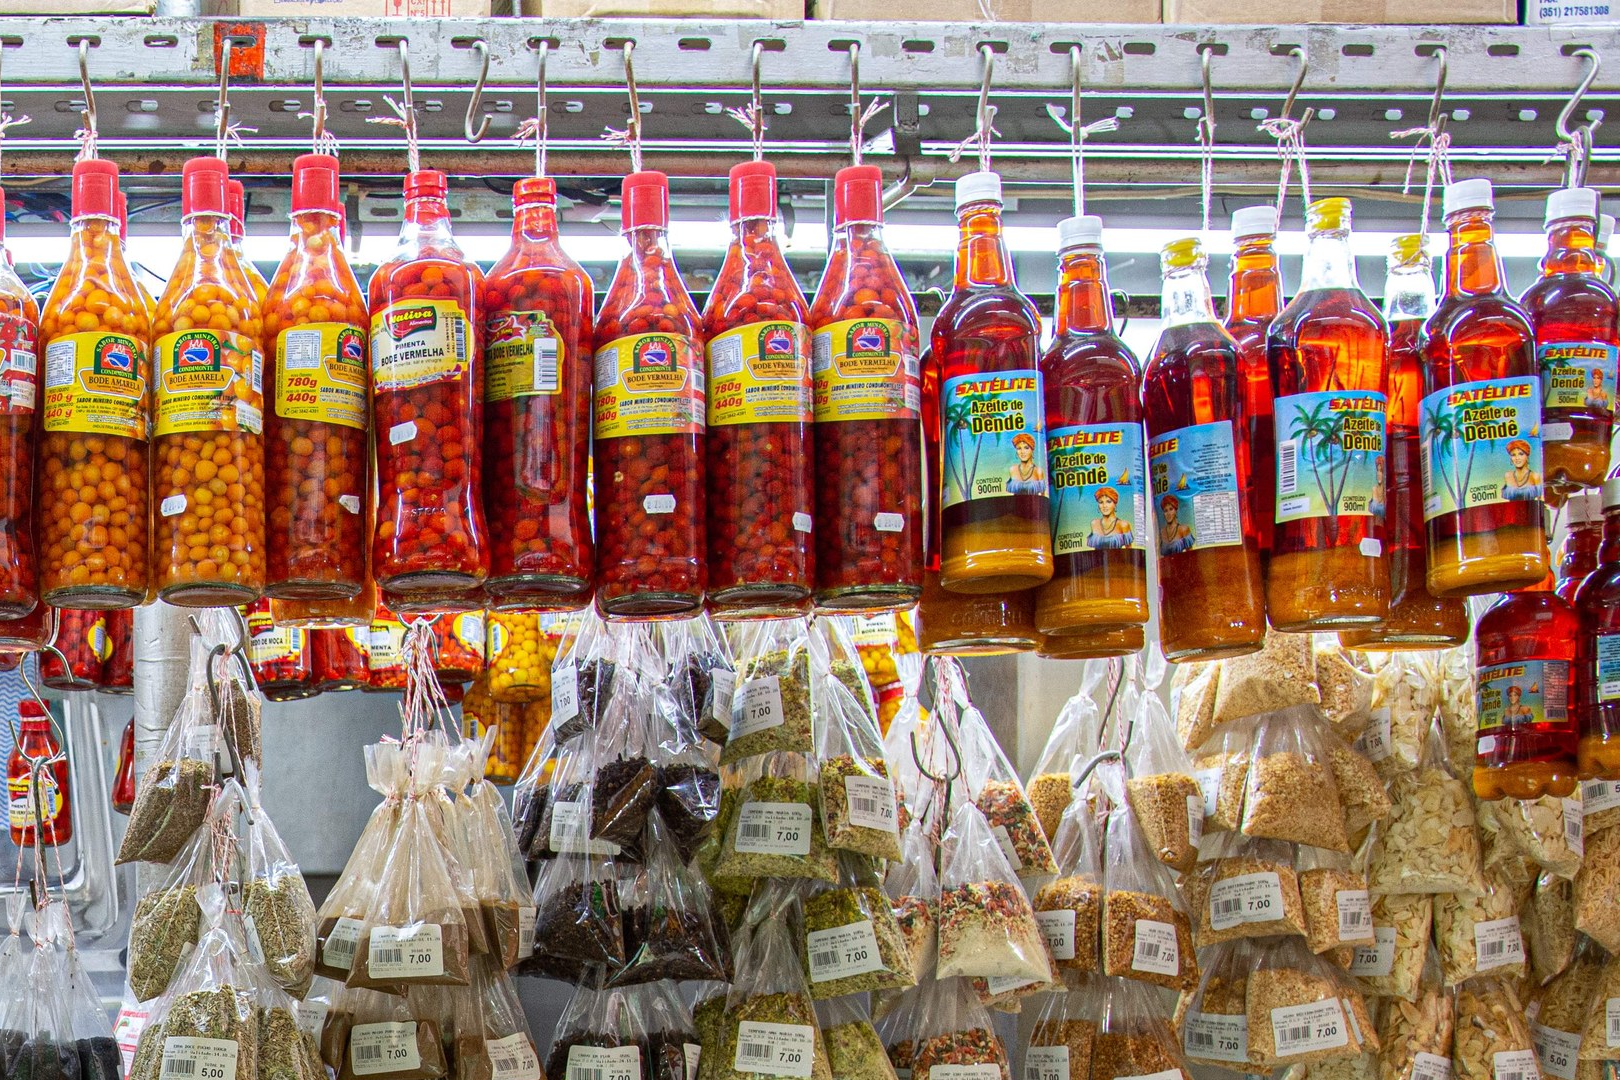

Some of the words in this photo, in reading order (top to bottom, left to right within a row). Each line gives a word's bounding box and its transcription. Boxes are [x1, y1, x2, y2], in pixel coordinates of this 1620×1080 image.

[1539, 7, 1561, 18] (351)
[1564, 6, 1609, 16] 217581308
[389, 310, 433, 325] Nativa
[395, 340, 425, 350] PIMENTA
[508, 344, 533, 357] VERMELHA
[381, 355, 398, 367] BODE
[400, 348, 444, 360] VERMELHA
[1545, 348, 1608, 359] SATÉLITE
[330, 364, 346, 372] BODE
[840, 359, 861, 368] BODE
[862, 358, 896, 367] VERMELHA
[169, 374, 187, 382] BODE
[188, 372, 225, 382] AMARELA
[1552, 367, 1576, 377] Azeite
[89, 376, 107, 385] BODE
[109, 377, 140, 391] AMARELA
[287, 377, 317, 387] 780g
[956, 376, 1036, 396] SATÉLITE
[1552, 377, 1584, 389] Dendê
[715, 382, 742, 395] 780g
[286, 392, 317, 403] 440g
[1447, 385, 1531, 406] SATÉLITE
[1558, 396, 1578, 404] 500ml
[715, 398, 742, 410] 440g
[971, 400, 1008, 414] Azeite
[1010, 400, 1023, 411] de
[1464, 410, 1500, 425] Azeite
[1503, 407, 1516, 417] de
[972, 413, 1024, 433] Dendê
[1344, 418, 1374, 431] Azeite
[1465, 420, 1519, 443] Dendê
[1055, 454, 1092, 468] Azeite
[1094, 453, 1106, 464] de
[976, 476, 1002, 486] CONTEÚDO
[1056, 465, 1107, 489] Dendê
[977, 483, 1002, 494] 900ml
[1470, 484, 1498, 494] CONTEÚDO
[1472, 491, 1498, 502] 900ml
[1344, 502, 1365, 512] 900ml
[1058, 532, 1084, 541] CONTEÚDO
[1059, 538, 1083, 550] 900ml
[270, 637, 284, 646] MOÇA
[776, 831, 799, 843] 7,00
[1247, 899, 1271, 911] 7,00
[408, 953, 432, 965] 7,00
[845, 950, 868, 963] 7,00
[1316, 1025, 1338, 1038] 7,00
[779, 1053, 801, 1064] 7,00
[200, 1067, 224, 1080] 5,00
